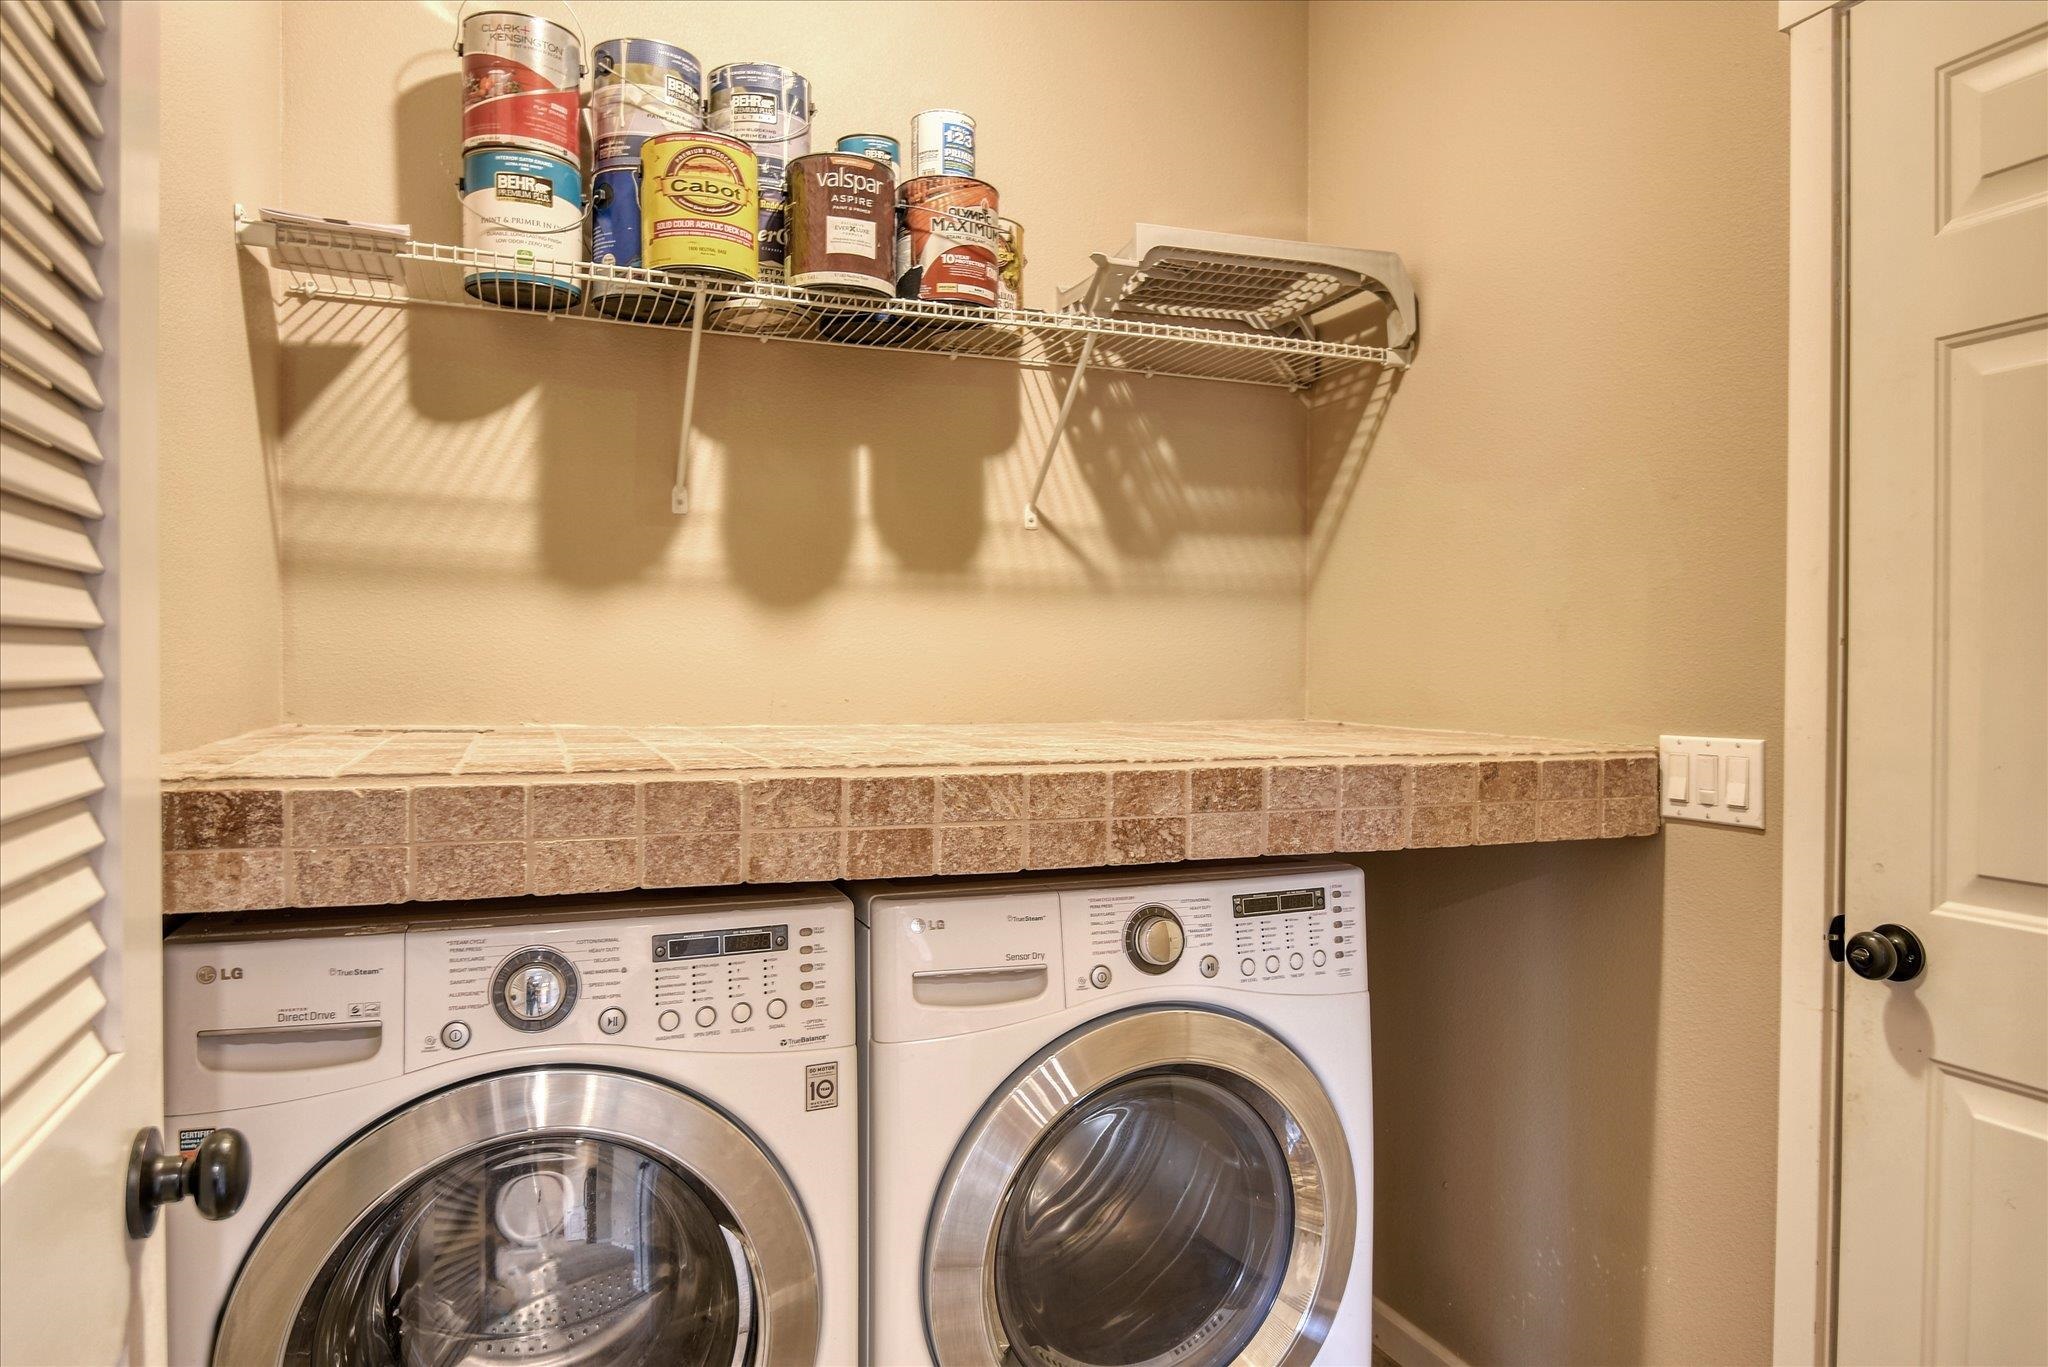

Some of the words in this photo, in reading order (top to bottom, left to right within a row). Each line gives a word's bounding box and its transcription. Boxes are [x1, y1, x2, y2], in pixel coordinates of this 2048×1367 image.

[668, 79, 692, 97] BEHR
[732, 95, 761, 107] BEHR
[675, 148, 704, 163] PREMIUM
[865, 150, 885, 160] BEHR
[498, 174, 535, 192] BEHR
[816, 166, 884, 195] valspar
[671, 180, 741, 201] Cabot
[831, 194, 873, 208] ASPIRE
[511, 217, 541, 227] PRIMER
[949, 207, 991, 226] OLYMPIC
[657, 221, 672, 230] SOLID
[673, 220, 694, 228] COLOR
[696, 221, 723, 231] ACRYLIC
[941, 254, 955, 264] 10
[760, 267, 773, 275] VET
[929, 920, 945, 930] LG
[1006, 953, 1031, 961] Sensor
[1032, 952, 1045, 961] Dry
[221, 967, 243, 980] LG
[278, 1013, 308, 1022] Direct
[310, 1011, 336, 1020] Drive
[810, 1079, 834, 1100] 10
